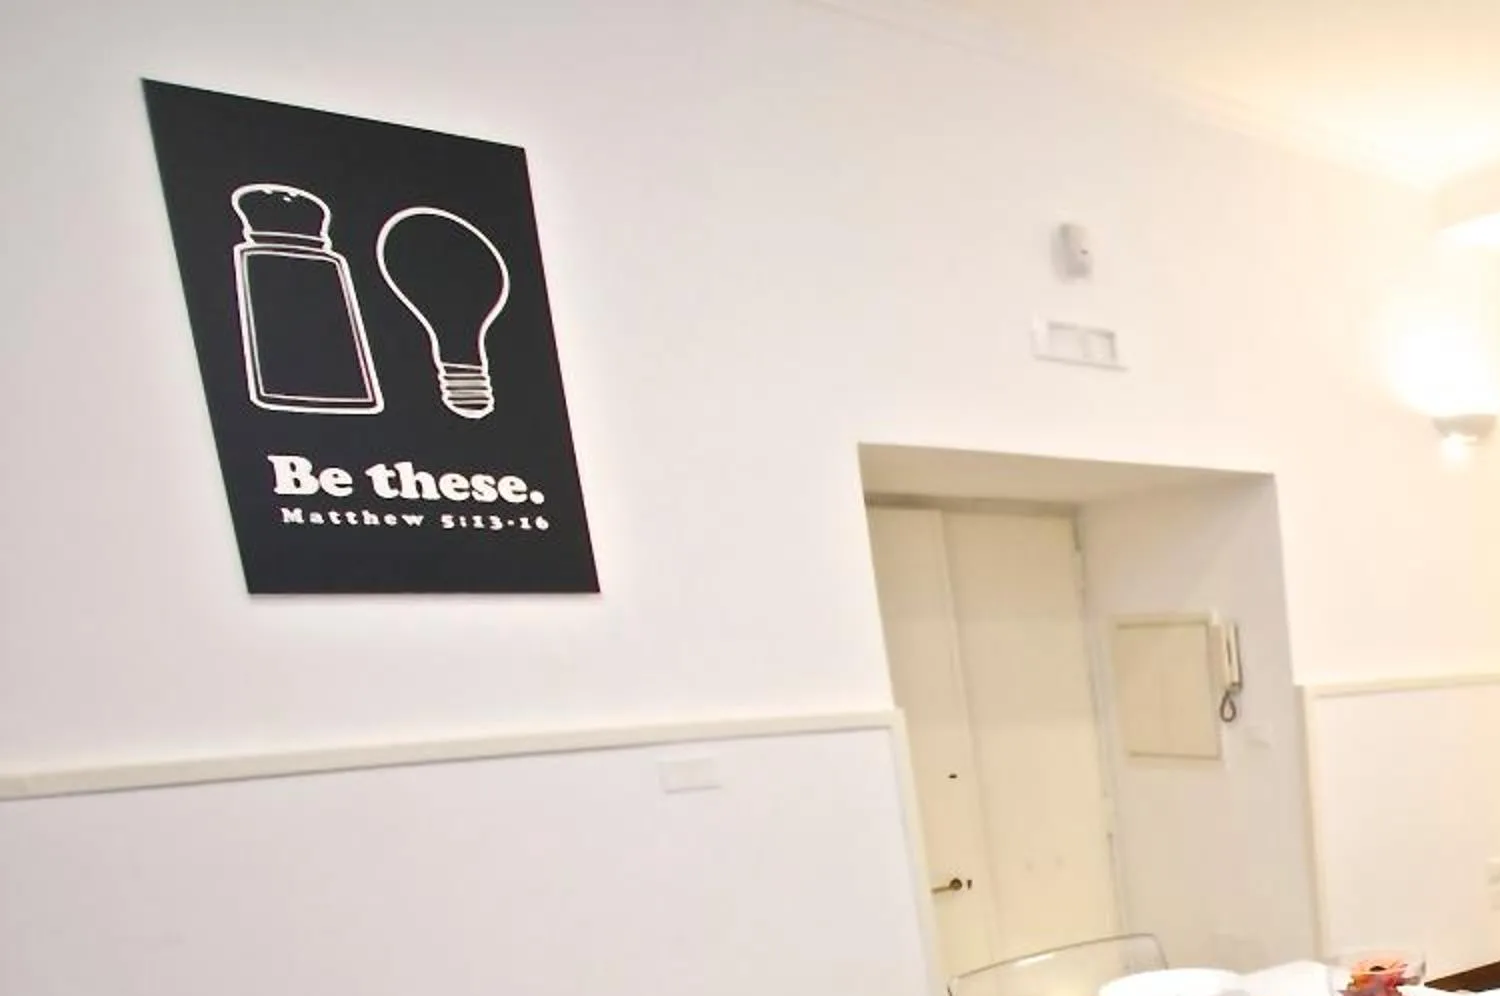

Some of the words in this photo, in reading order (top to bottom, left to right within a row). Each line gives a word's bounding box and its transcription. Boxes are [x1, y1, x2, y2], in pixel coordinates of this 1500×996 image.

[268, 454, 353, 497] Be
[364, 461, 545, 505] these.
[280, 508, 425, 527] Matthew
[440, 514, 550, 531] 5:13-16
